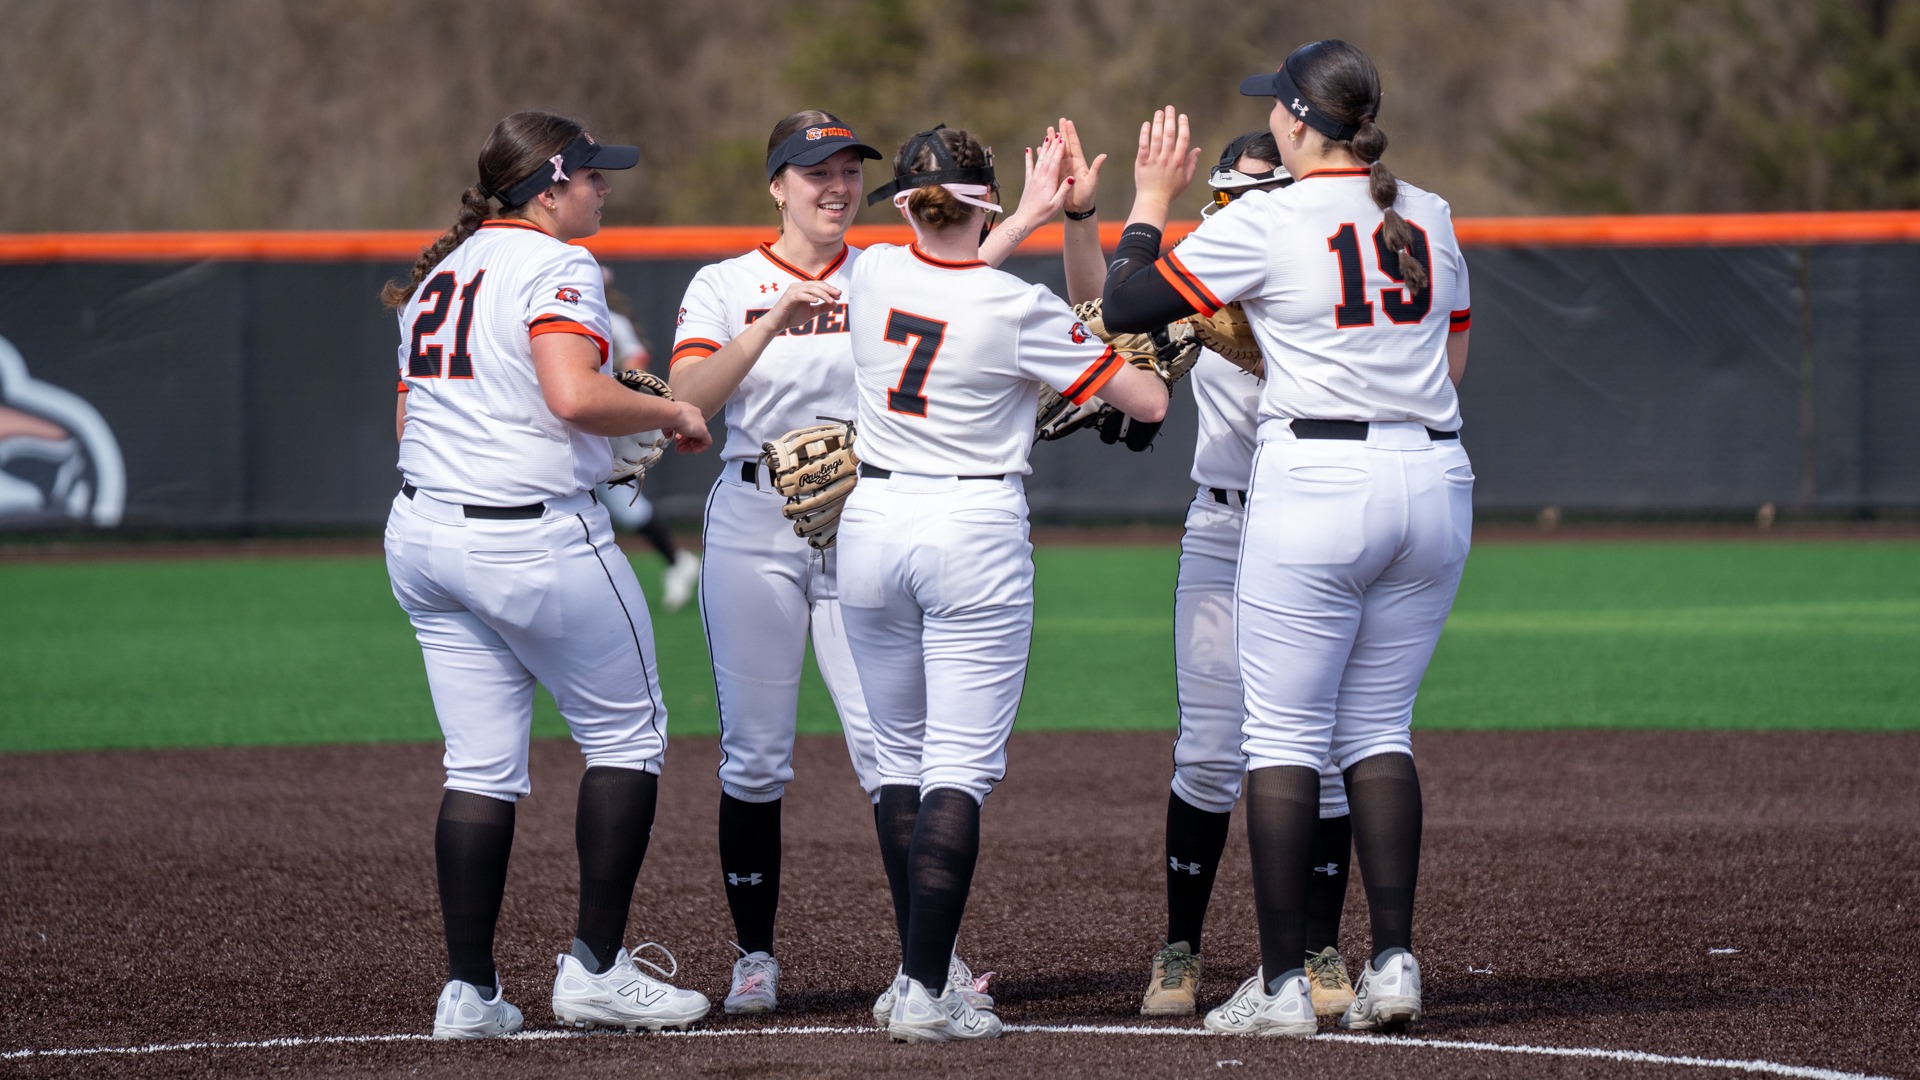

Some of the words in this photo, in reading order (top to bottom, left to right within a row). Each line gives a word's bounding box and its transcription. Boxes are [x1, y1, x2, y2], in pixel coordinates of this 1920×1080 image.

[405, 268, 487, 380] 21
[1327, 219, 1433, 329] 19
[883, 307, 949, 418] 7
[799, 458, 844, 488] Rawlings
[617, 979, 668, 1007] N
